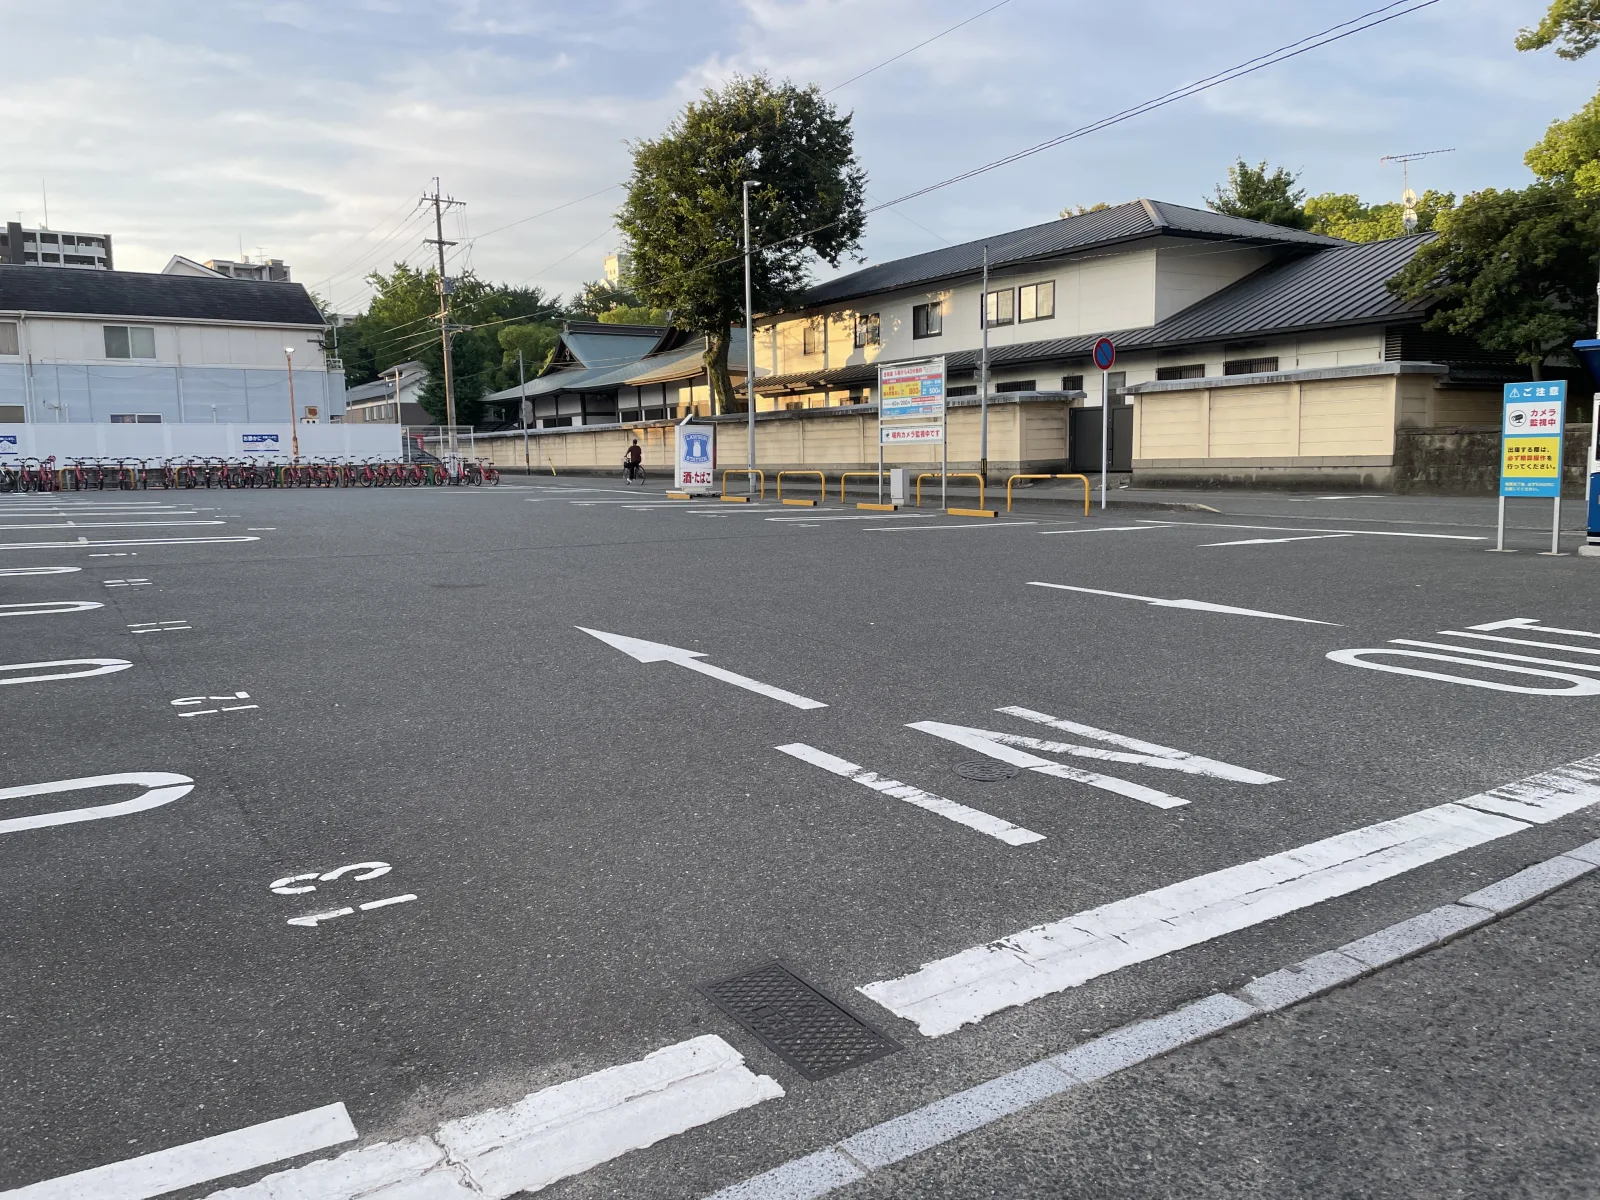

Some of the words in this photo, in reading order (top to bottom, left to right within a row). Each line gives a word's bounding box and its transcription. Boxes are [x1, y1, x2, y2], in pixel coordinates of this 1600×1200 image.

[1523, 386, 1560, 397] ご注意
[1530, 408, 1557, 417] カメラ
[1529, 418, 1556, 427] 監視中
[1506, 463, 1557, 471] 行ってください。
